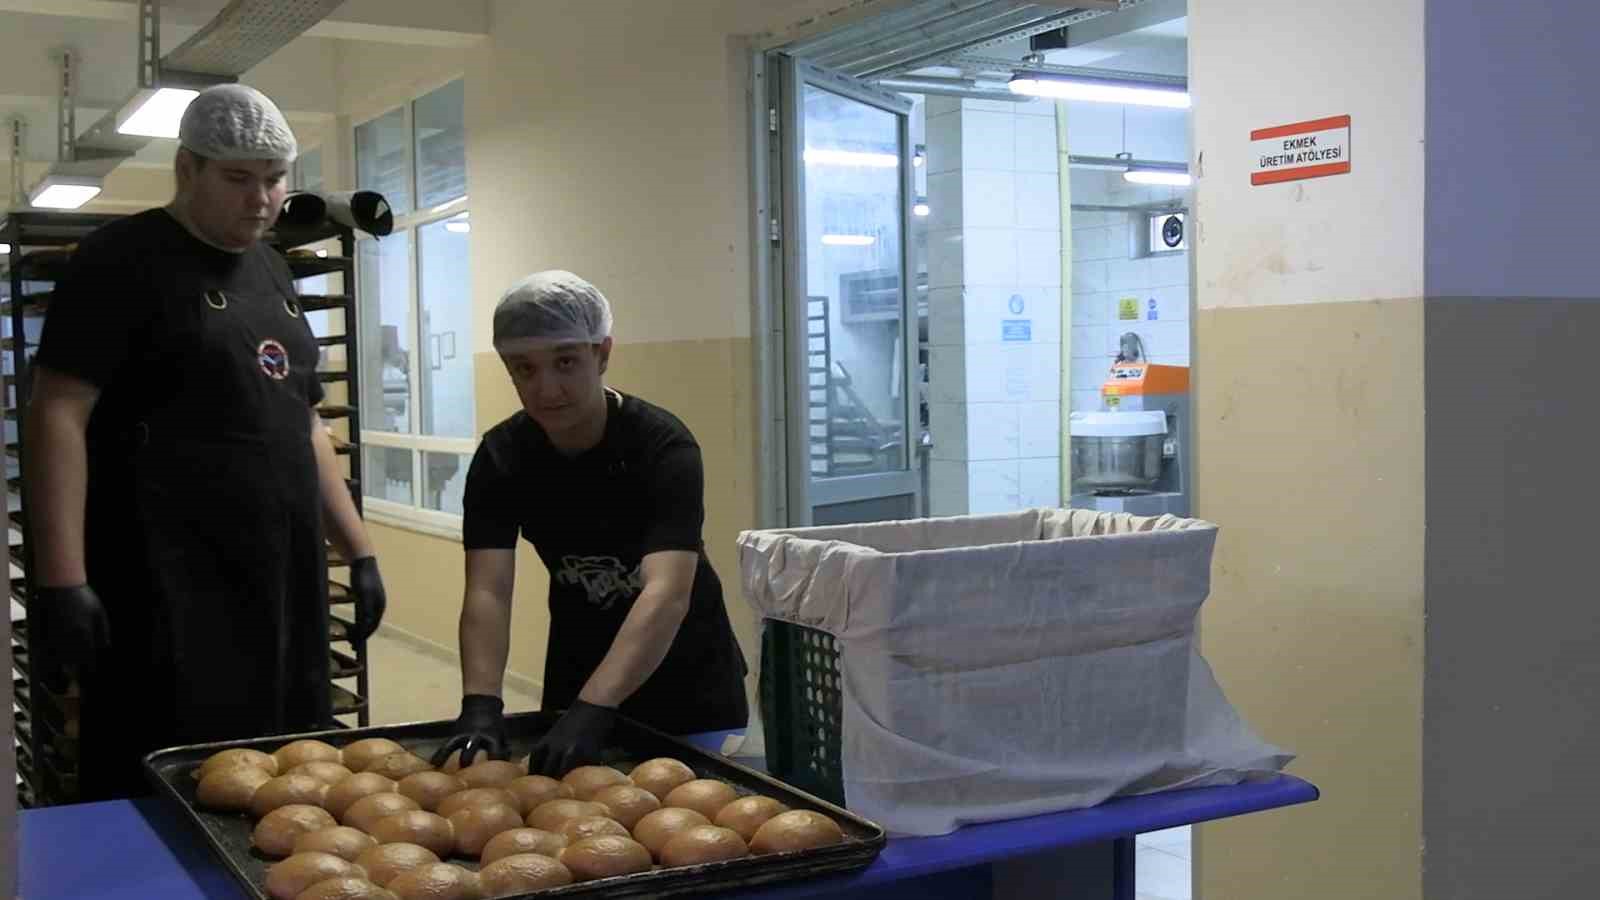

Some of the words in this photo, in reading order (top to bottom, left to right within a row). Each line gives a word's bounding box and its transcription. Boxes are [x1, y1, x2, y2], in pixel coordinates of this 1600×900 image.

[1283, 136, 1317, 151] EKMEK
[1260, 152, 1294, 168] ÜRETİM
[1296, 144, 1342, 163] ATÖLYESİ
